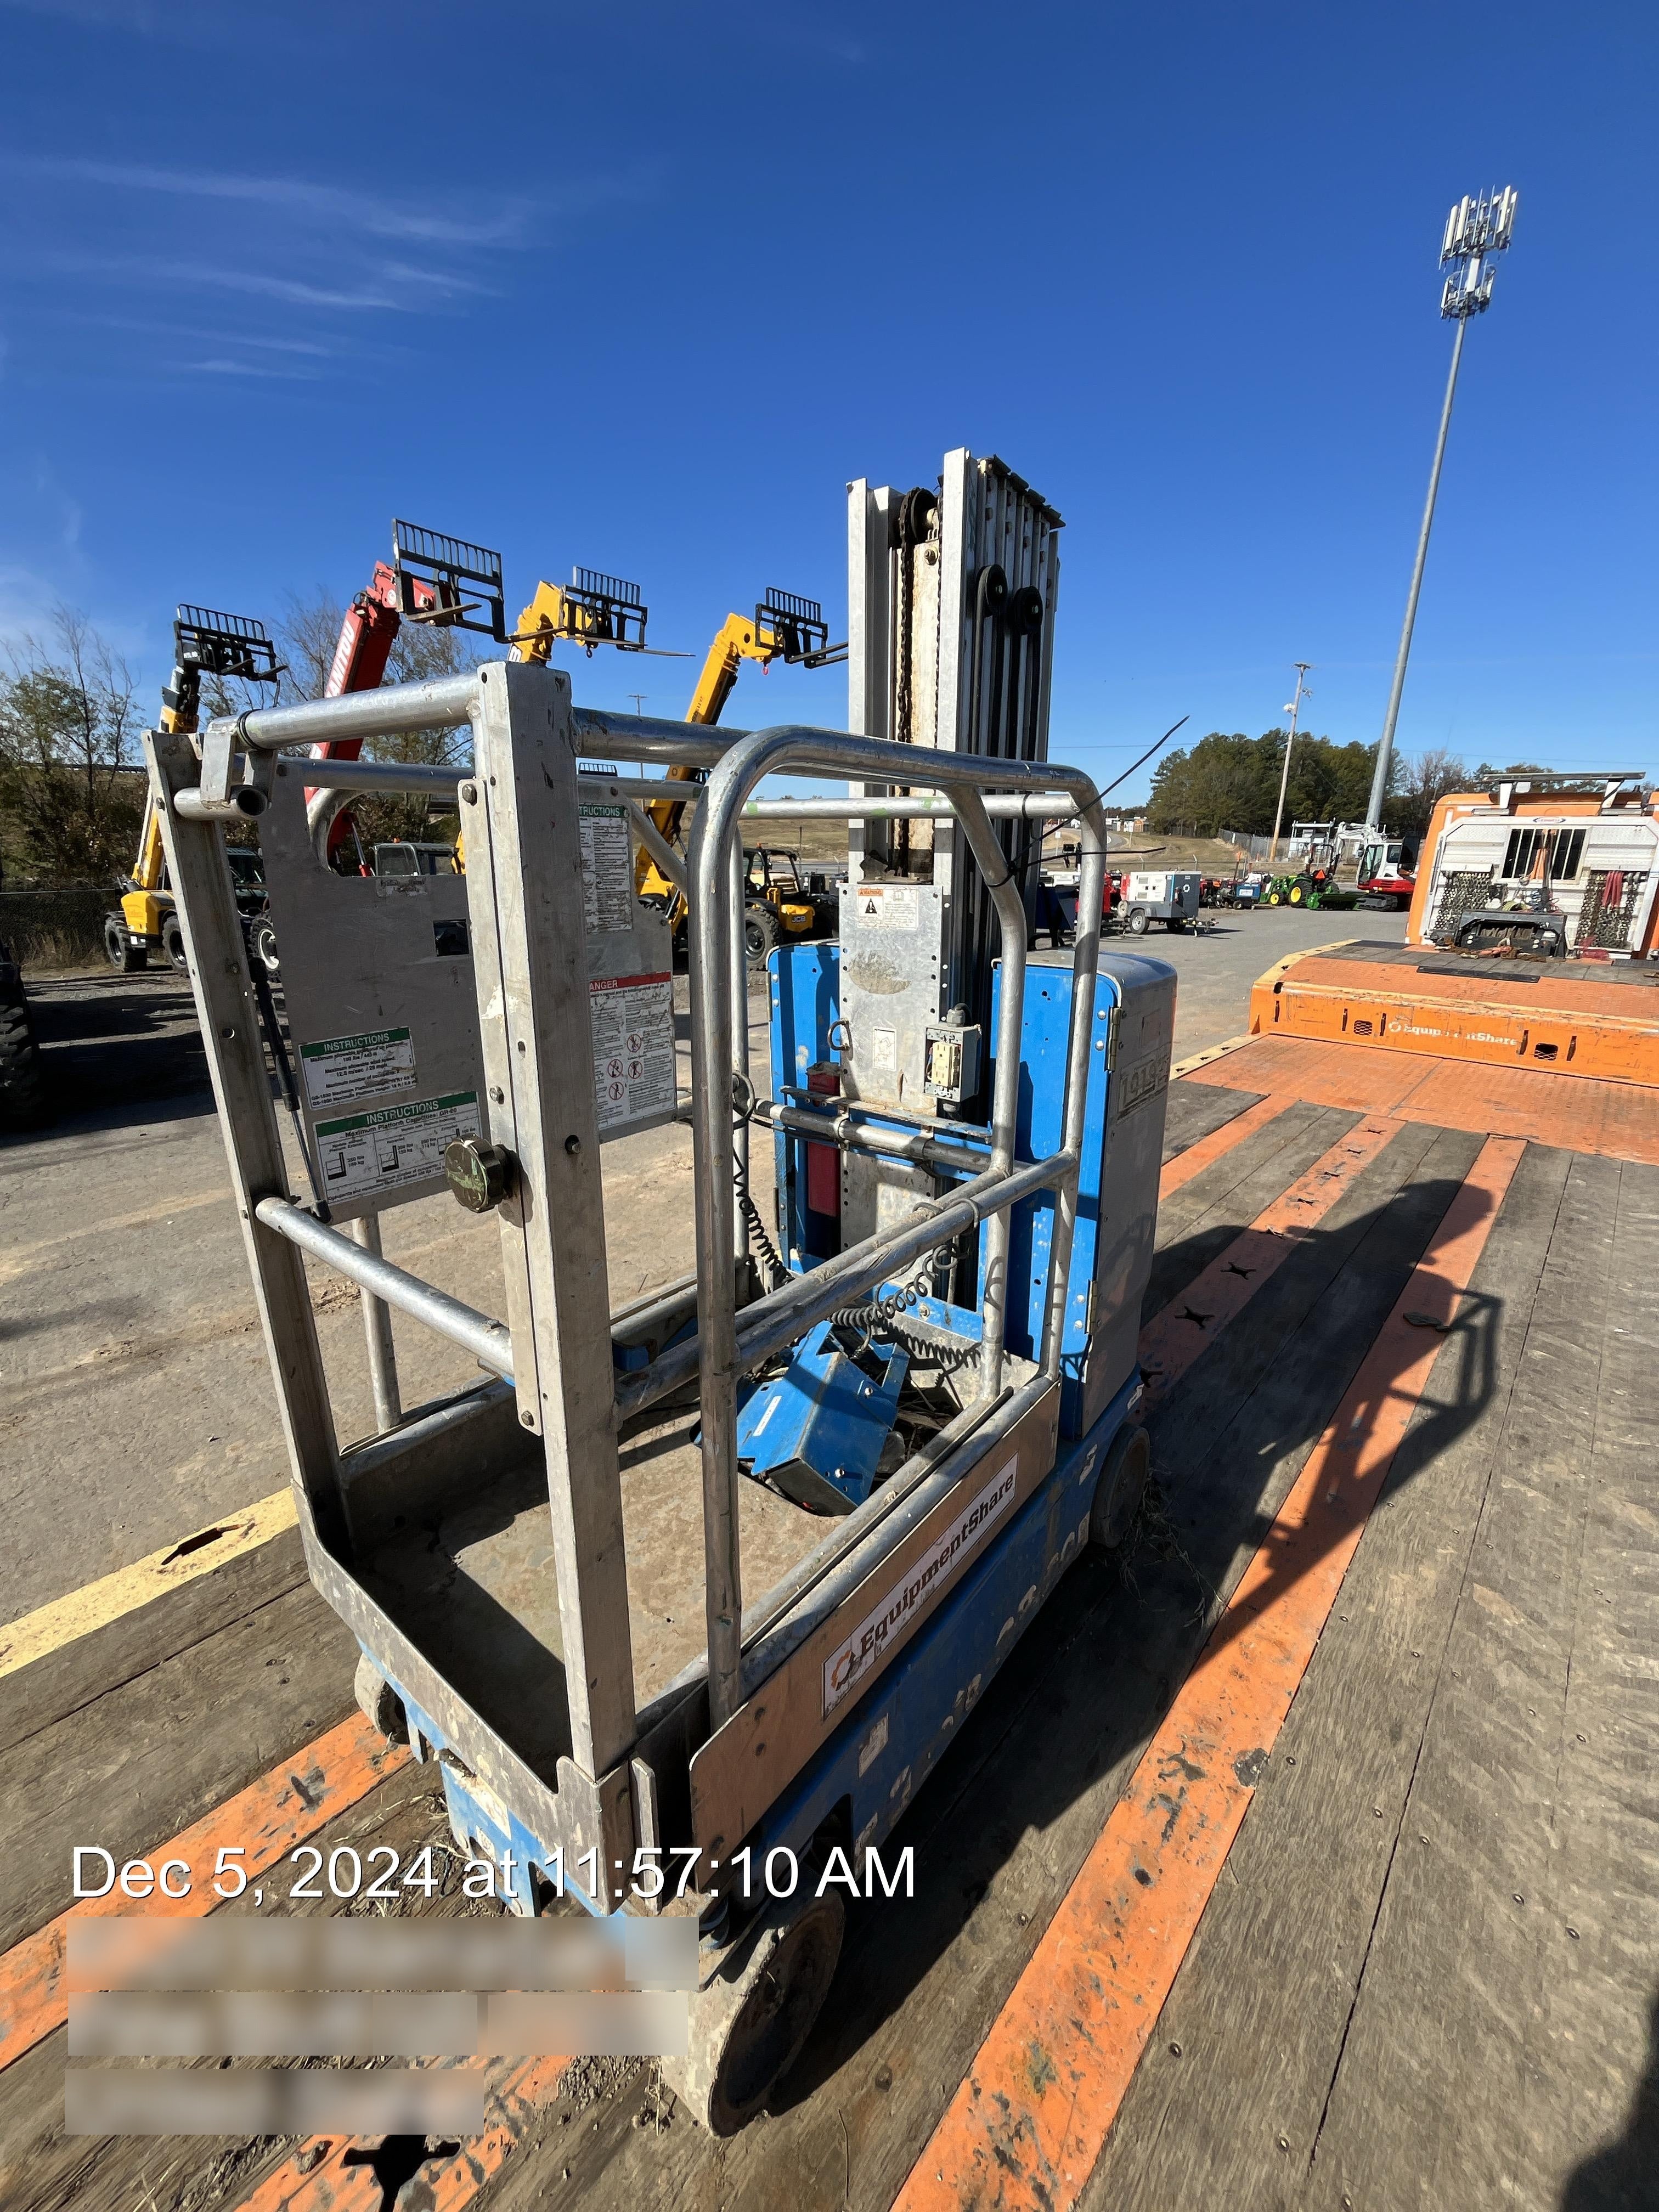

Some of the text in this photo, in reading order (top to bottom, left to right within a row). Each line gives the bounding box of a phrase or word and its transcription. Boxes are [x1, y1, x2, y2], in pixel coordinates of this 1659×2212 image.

[324, 1033, 390, 1052] INSTRUCTIONS
[345, 1126, 376, 1138] Maximum
[378, 1120, 404, 1130] Platform
[405, 1111, 438, 1124] Capacities:
[366, 1100, 439, 1125] INSTRUCTIONS
[859, 1473, 1014, 1655] EquipmentShare
